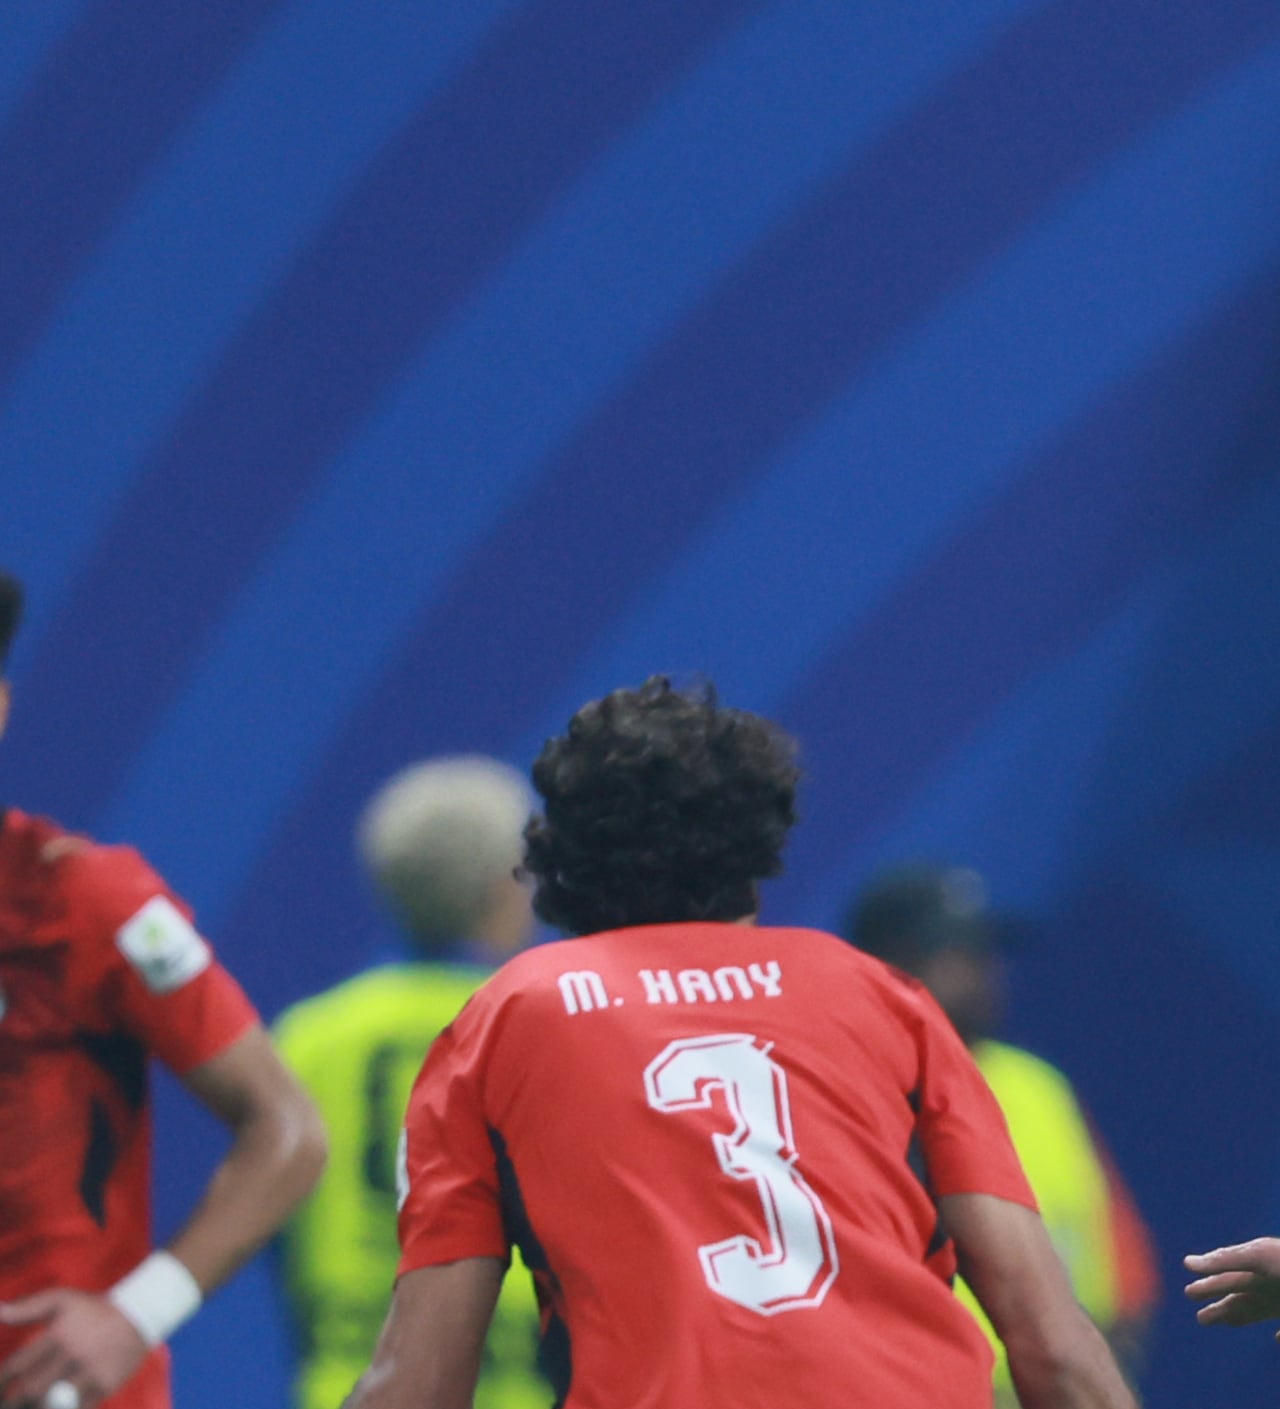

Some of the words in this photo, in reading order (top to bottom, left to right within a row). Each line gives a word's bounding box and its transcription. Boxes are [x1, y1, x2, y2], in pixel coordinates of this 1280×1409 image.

[557, 970, 625, 1016] M.
[638, 960, 783, 1005] HANY
[642, 1032, 840, 1317] 3
